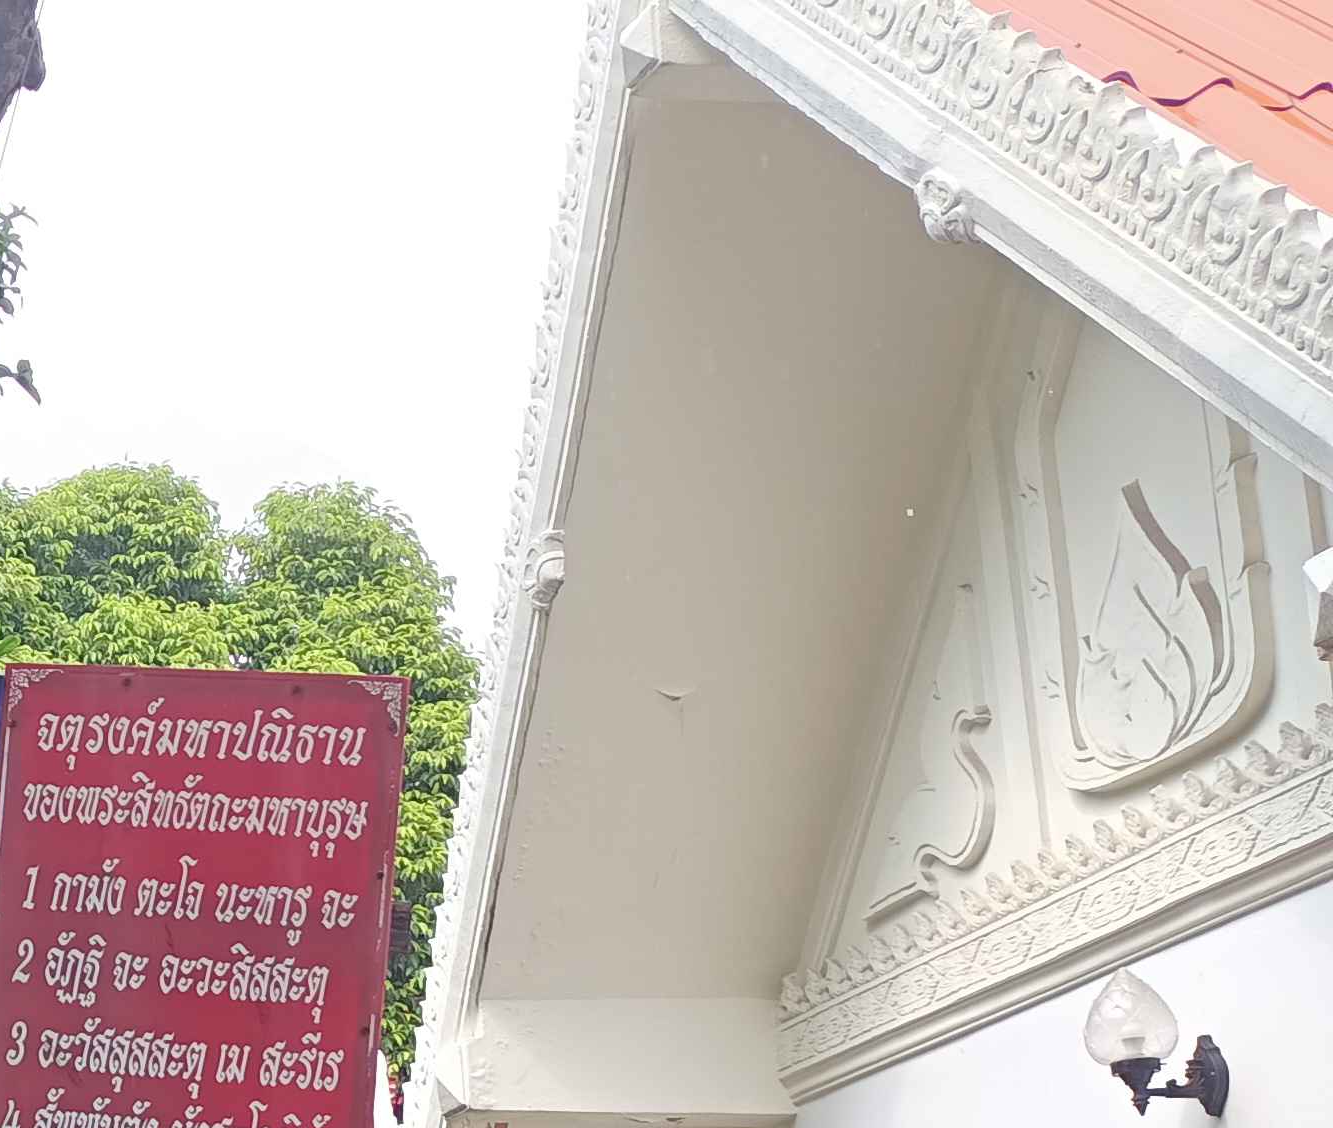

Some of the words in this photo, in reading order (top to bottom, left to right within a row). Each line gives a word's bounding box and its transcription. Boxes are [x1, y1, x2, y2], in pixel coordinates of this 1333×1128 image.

[37, 698, 366, 771] จตุรงค์มหาปณิธาน
[23, 771, 368, 859] ของพระสิทธัตถะมหาบุรุษ
[23, 865, 39, 910] 1
[50, 858, 126, 916] กามัง
[134, 855, 203, 922] ตะโจ
[215, 883, 312, 946] นะหารู
[321, 889, 358, 930] จะ
[12, 939, 34, 984] 2
[44, 931, 107, 1008] อัฏฐิ
[112, 951, 149, 992] จะ
[5, 1020, 28, 1066] 3
[215, 1043, 251, 1084] เม
[259, 1031, 345, 1092] สะรีเร
